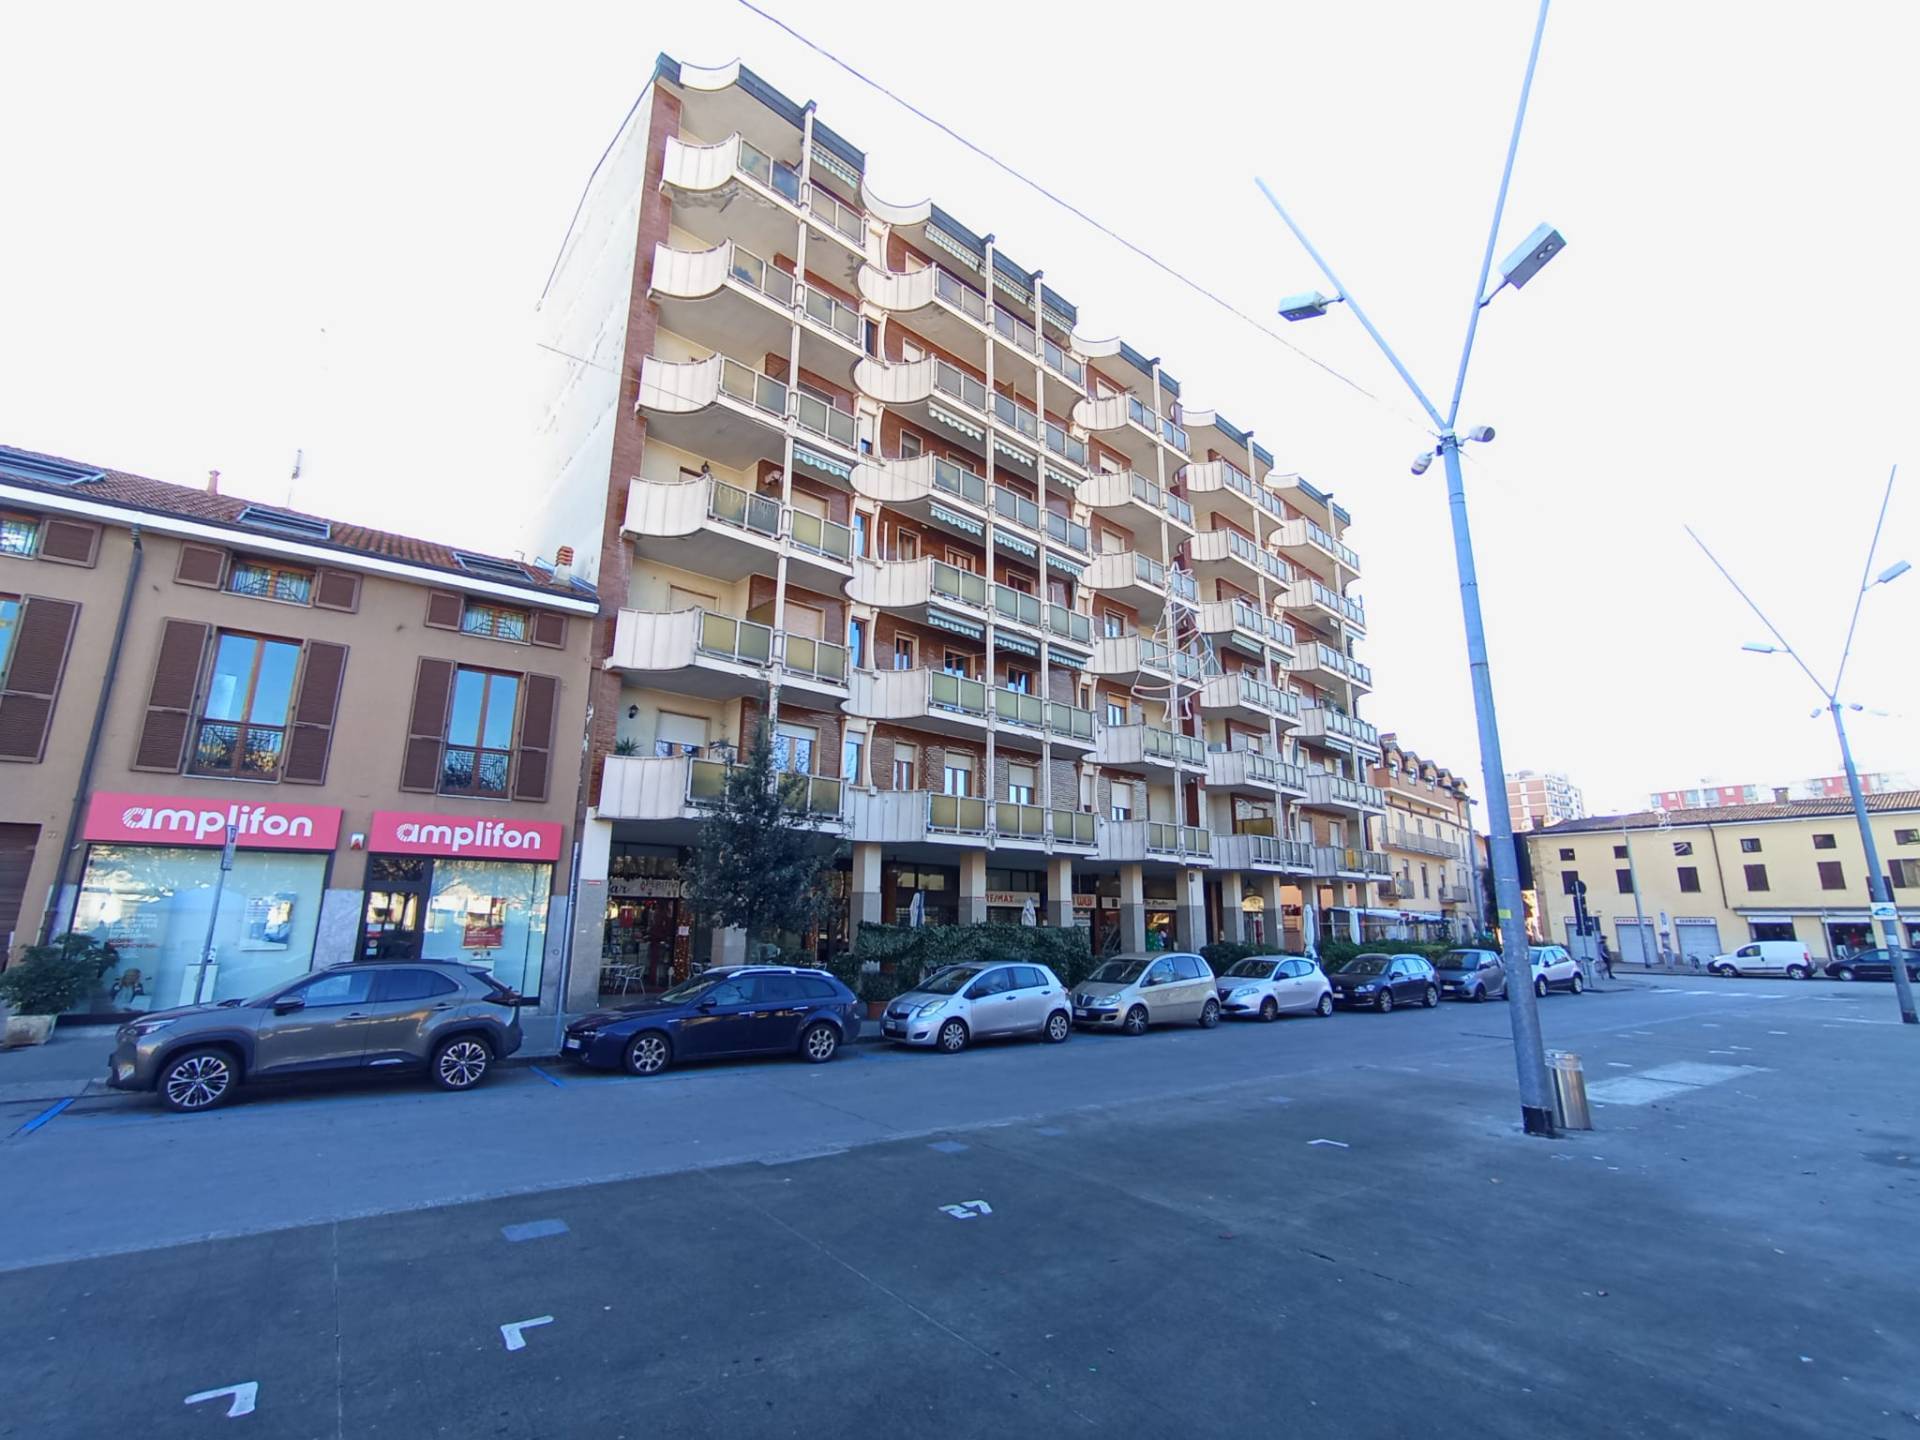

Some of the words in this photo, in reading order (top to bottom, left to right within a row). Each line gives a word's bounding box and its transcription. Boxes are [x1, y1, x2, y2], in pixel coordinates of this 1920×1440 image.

[122, 804, 313, 840] amplifon
[396, 820, 541, 852] amplifon
[938, 1200, 992, 1219] 27
